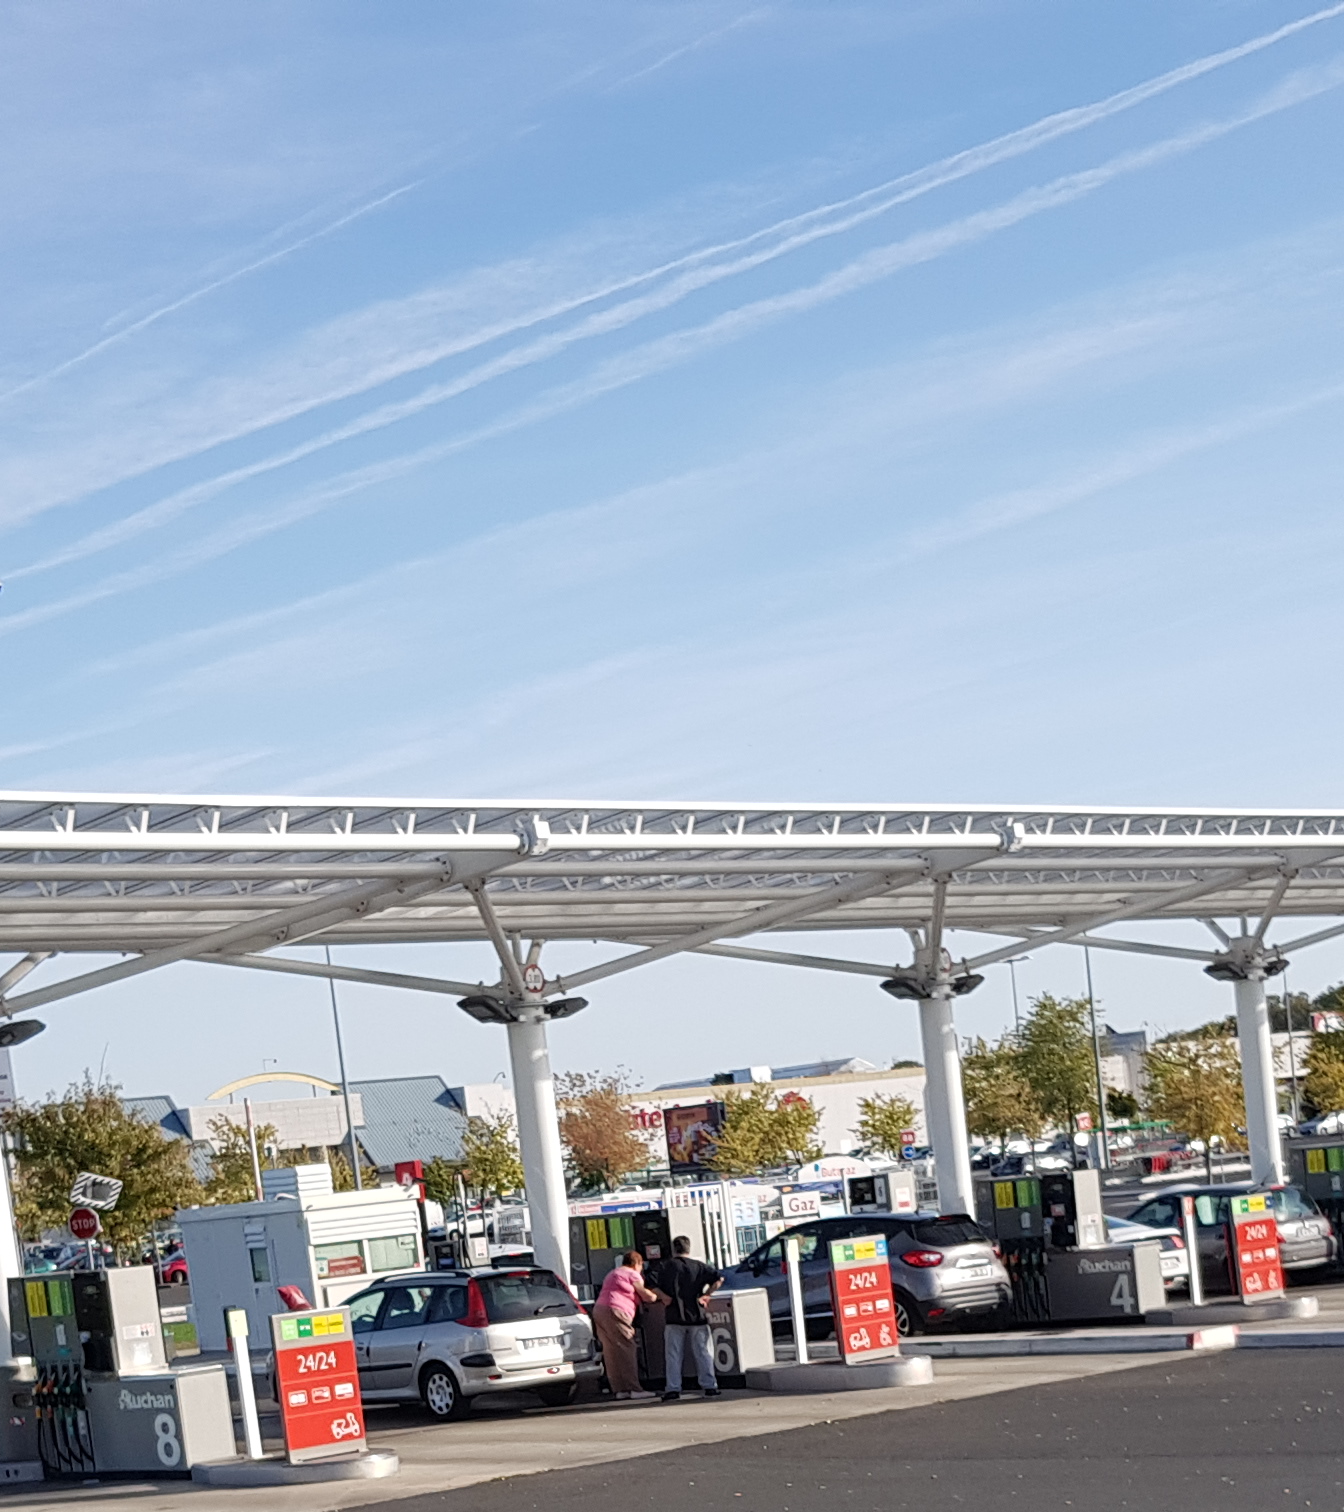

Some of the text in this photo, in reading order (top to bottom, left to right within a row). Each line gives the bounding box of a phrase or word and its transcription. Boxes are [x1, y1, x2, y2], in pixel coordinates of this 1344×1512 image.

[788, 1197, 816, 1212] Gaz
[71, 1218, 96, 1231] STOP
[1077, 1258, 1132, 1274] Auchan
[848, 1271, 877, 1290] 24/24
[1109, 1273, 1135, 1314] 4
[712, 1327, 735, 1373] 6
[296, 1350, 337, 1374] 24/24
[118, 1389, 175, 1410] Auchan
[154, 1412, 181, 1467] 8
